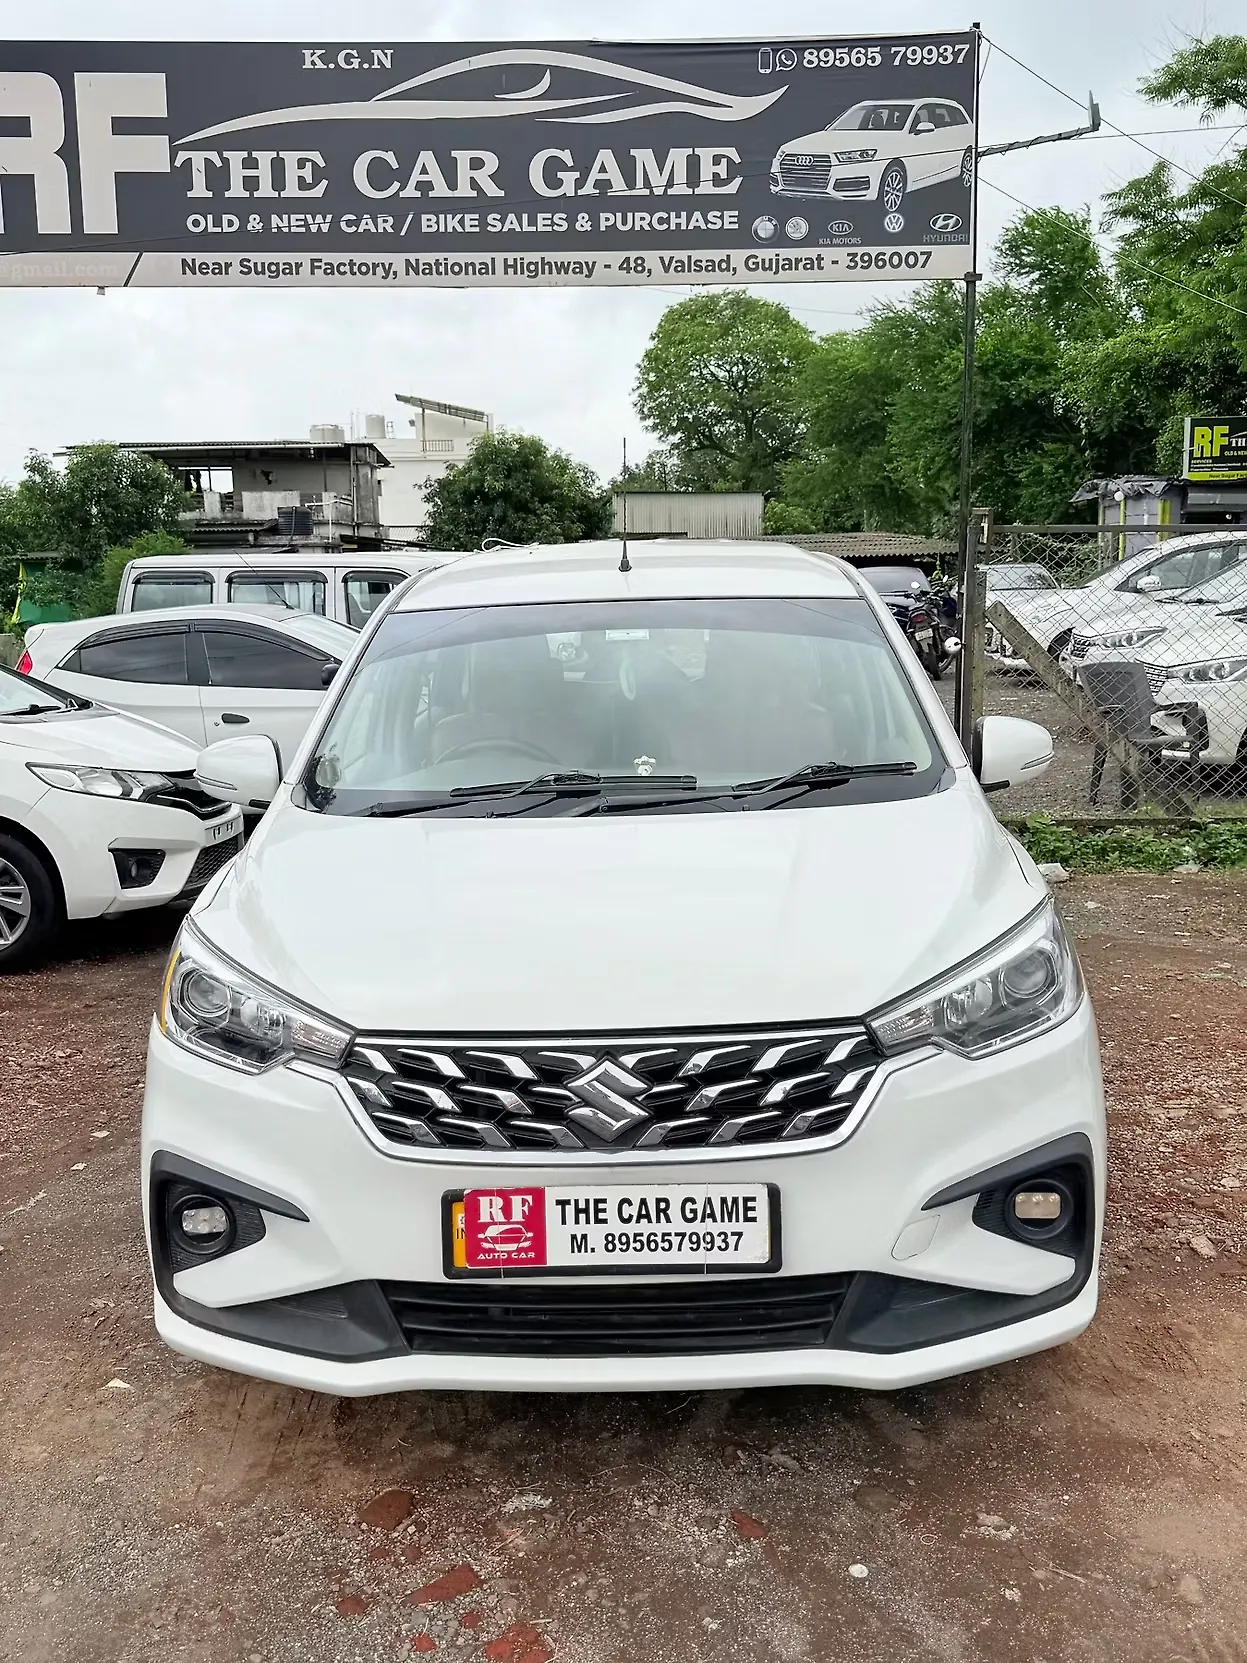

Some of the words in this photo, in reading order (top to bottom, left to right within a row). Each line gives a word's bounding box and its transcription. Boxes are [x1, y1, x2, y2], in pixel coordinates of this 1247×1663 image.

[302, 49, 393, 69] K.G.N
[803, 47, 883, 68] 89565
[891, 44, 970, 66] 79937
[174, 150, 328, 198] THE
[353, 149, 504, 199] CAR
[529, 147, 743, 198] GAME
[186, 213, 240, 233] OLD
[246, 213, 264, 233] &
[271, 213, 332, 233] NEW
[339, 214, 395, 233] CAR
[400, 212, 414, 236] /
[420, 213, 480, 233] BIKE
[486, 212, 570, 232] SALES
[575, 212, 593, 232] &
[599, 210, 739, 231] PURCHASE
[832, 237, 862, 245] MOTORS
[923, 234, 968, 243] HYUNDAI
[180, 258, 233, 276] Near
[238, 257, 303, 280] Sugar
[309, 258, 398, 280] Factory,
[404, 257, 496, 276] National
[503, 256, 597, 279] Highway
[618, 256, 652, 278] 48,
[658, 254, 737, 275] Valsad,
[744, 253, 825, 275] Gujarat
[846, 251, 933, 270] 396007
[1193, 425, 1229, 457] RF
[477, 1195, 533, 1223] RF
[555, 1198, 609, 1226] THE
[617, 1197, 672, 1225] CAR
[680, 1195, 758, 1223] GAME
[570, 1233, 596, 1254] M.
[603, 1231, 744, 1253] 8956579937
[477, 1252, 508, 1260] AUTO
